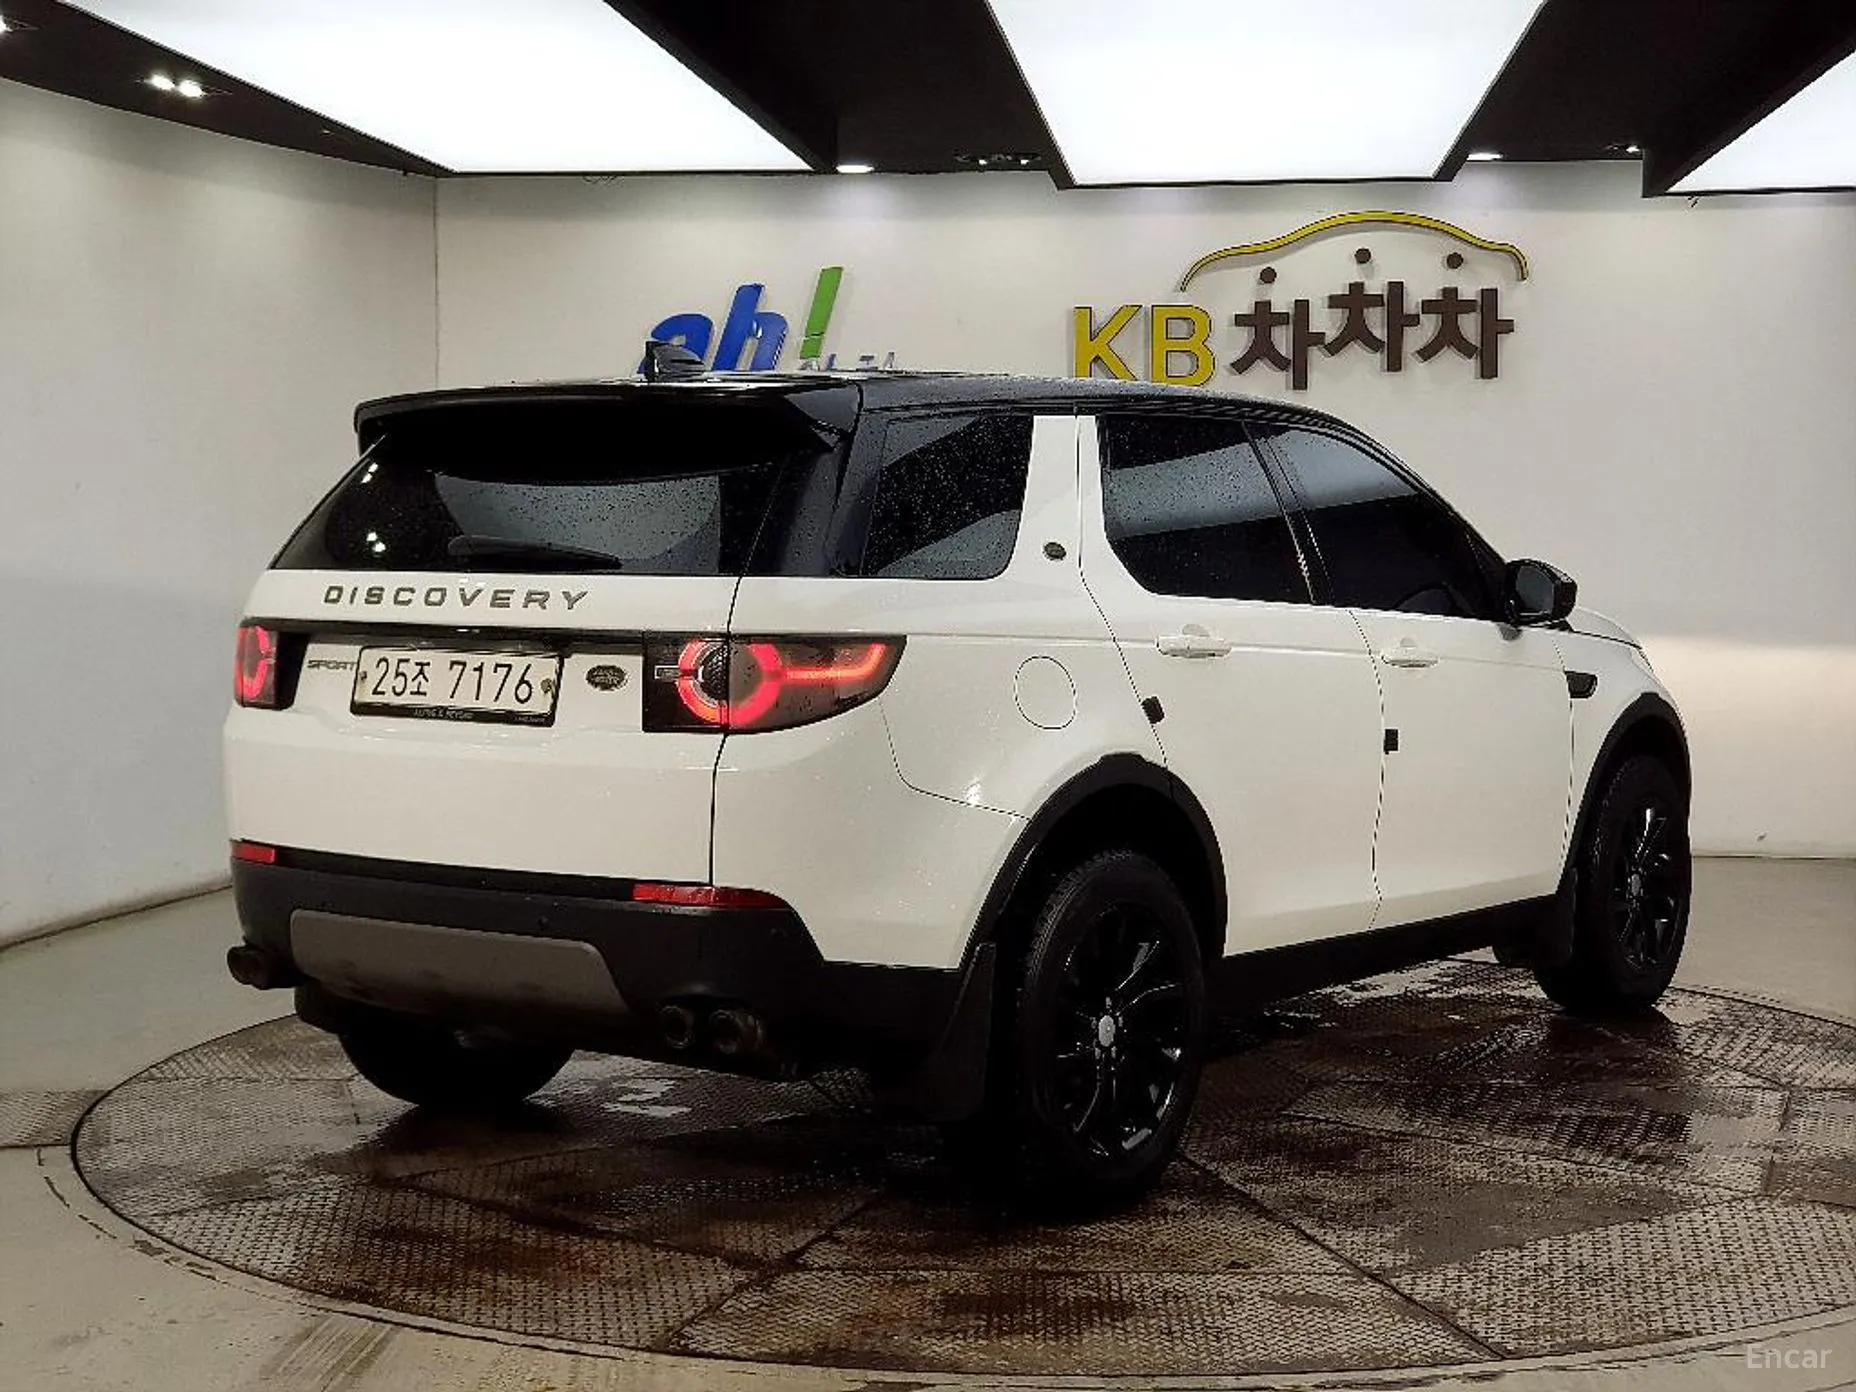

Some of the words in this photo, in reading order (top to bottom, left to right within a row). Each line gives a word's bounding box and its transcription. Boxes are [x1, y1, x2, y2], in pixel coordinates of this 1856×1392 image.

[1073, 303, 1216, 387] KB
[1229, 246, 1515, 391] 차차차
[323, 584, 590, 611] DISCOVERY
[306, 659, 357, 671] SPORT
[371, 656, 431, 697] 25조
[448, 658, 534, 705] 7176
